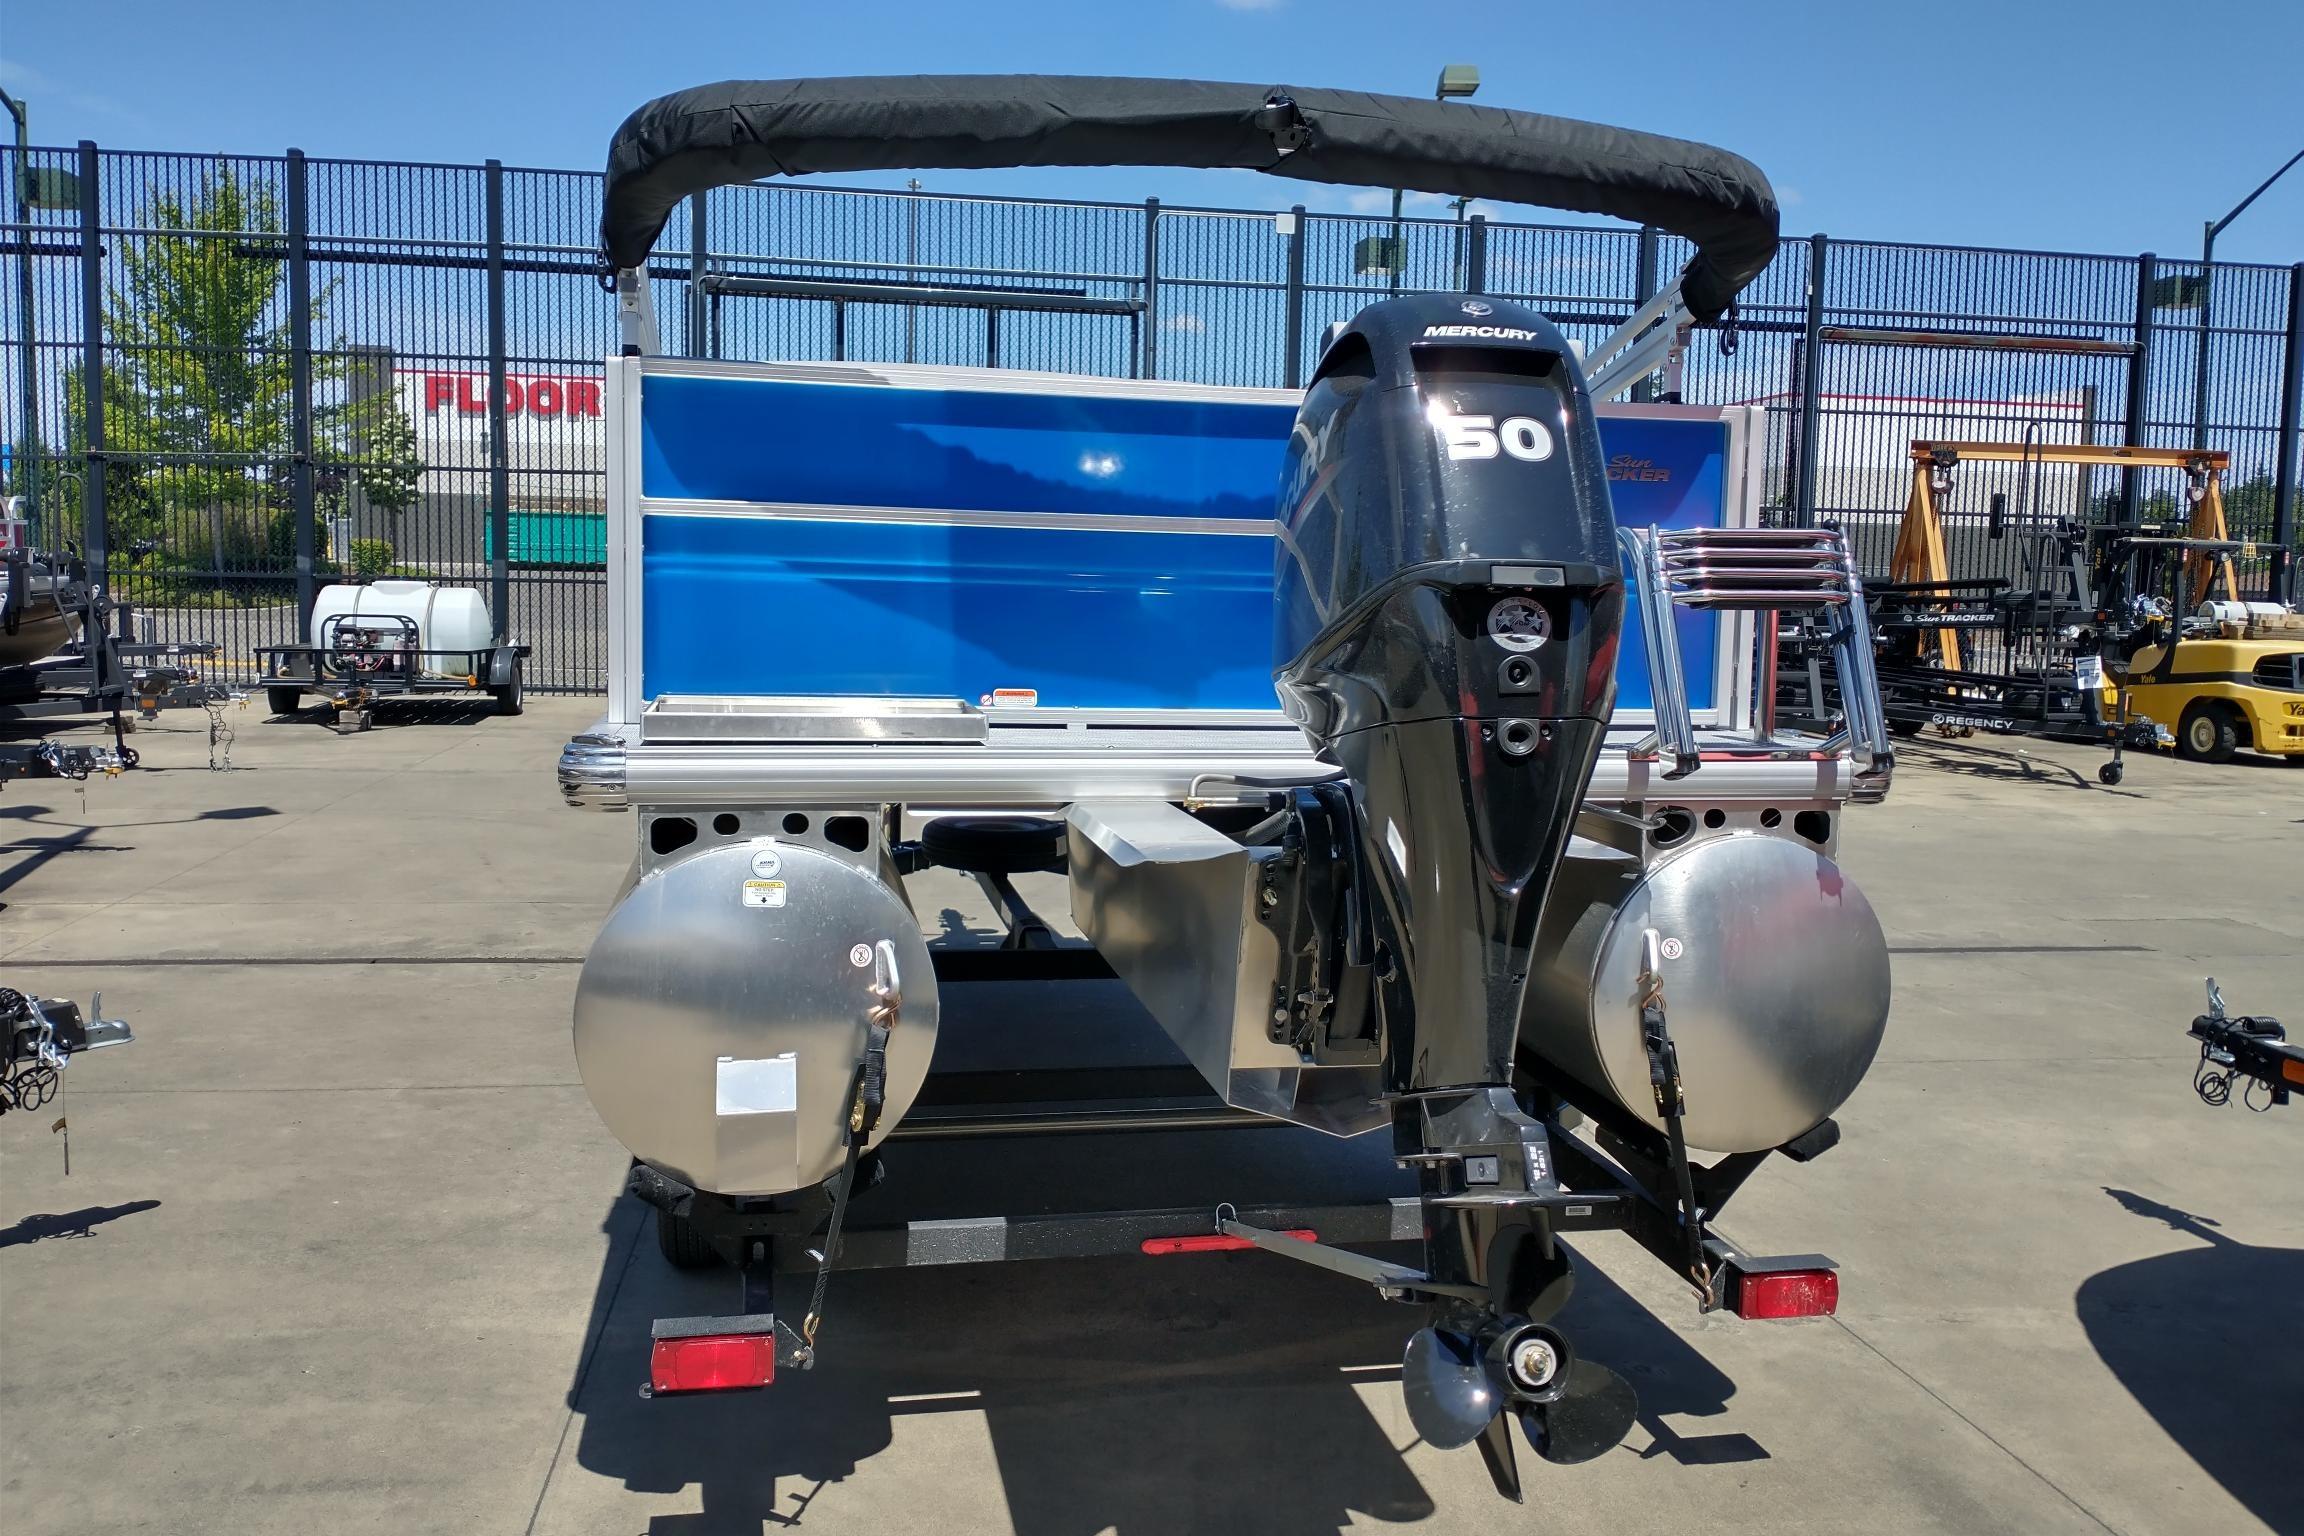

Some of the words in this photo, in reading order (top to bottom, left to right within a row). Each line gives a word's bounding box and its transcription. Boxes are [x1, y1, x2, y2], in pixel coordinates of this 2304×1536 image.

[1423, 325, 1539, 341] MERCURY
[425, 376, 602, 420] FLOOR
[1446, 414, 1554, 462] 50
[1608, 454, 1655, 468] Sun
[1606, 468, 1671, 481] CKER
[1913, 613, 1940, 622] Sun
[1940, 614, 1996, 622] TRACKER
[2140, 674, 2156, 684] Yale
[2289, 703, 2304, 716] Ya
[1945, 716, 2014, 729] REGENCY
